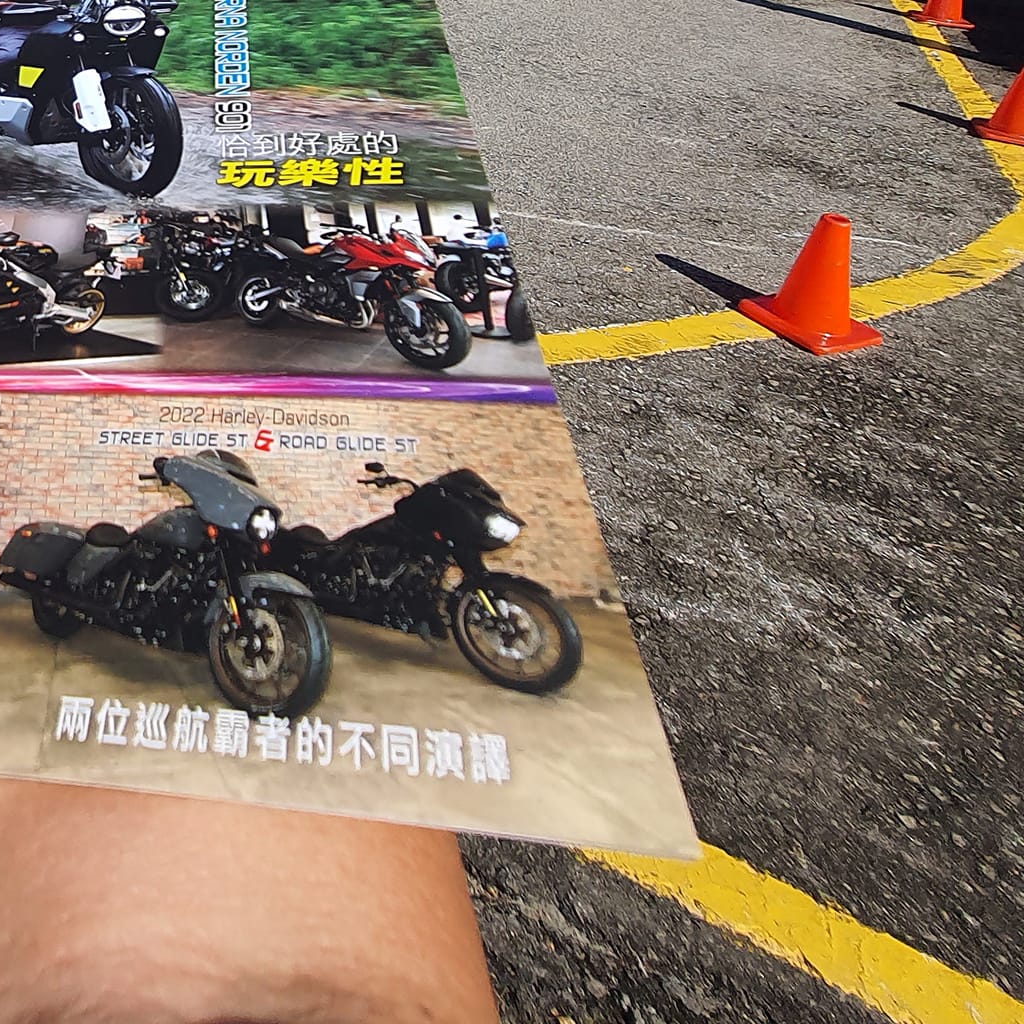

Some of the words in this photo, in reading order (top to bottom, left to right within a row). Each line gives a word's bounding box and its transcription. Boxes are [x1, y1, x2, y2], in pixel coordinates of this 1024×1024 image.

[214, 30, 251, 97] NORDEN
[215, 100, 252, 133] 901
[219, 130, 400, 158] 恰到好處的
[216, 156, 405, 188] 玩樂性
[159, 406, 206, 424] 2022
[211, 407, 350, 427] Harley-Davidson
[98, 431, 166, 446] STREET
[171, 432, 219, 447] GLIDE
[226, 433, 249, 448] ST
[279, 434, 328, 450] ROAD
[335, 435, 386, 452] GLIDE
[393, 437, 419, 452] ST
